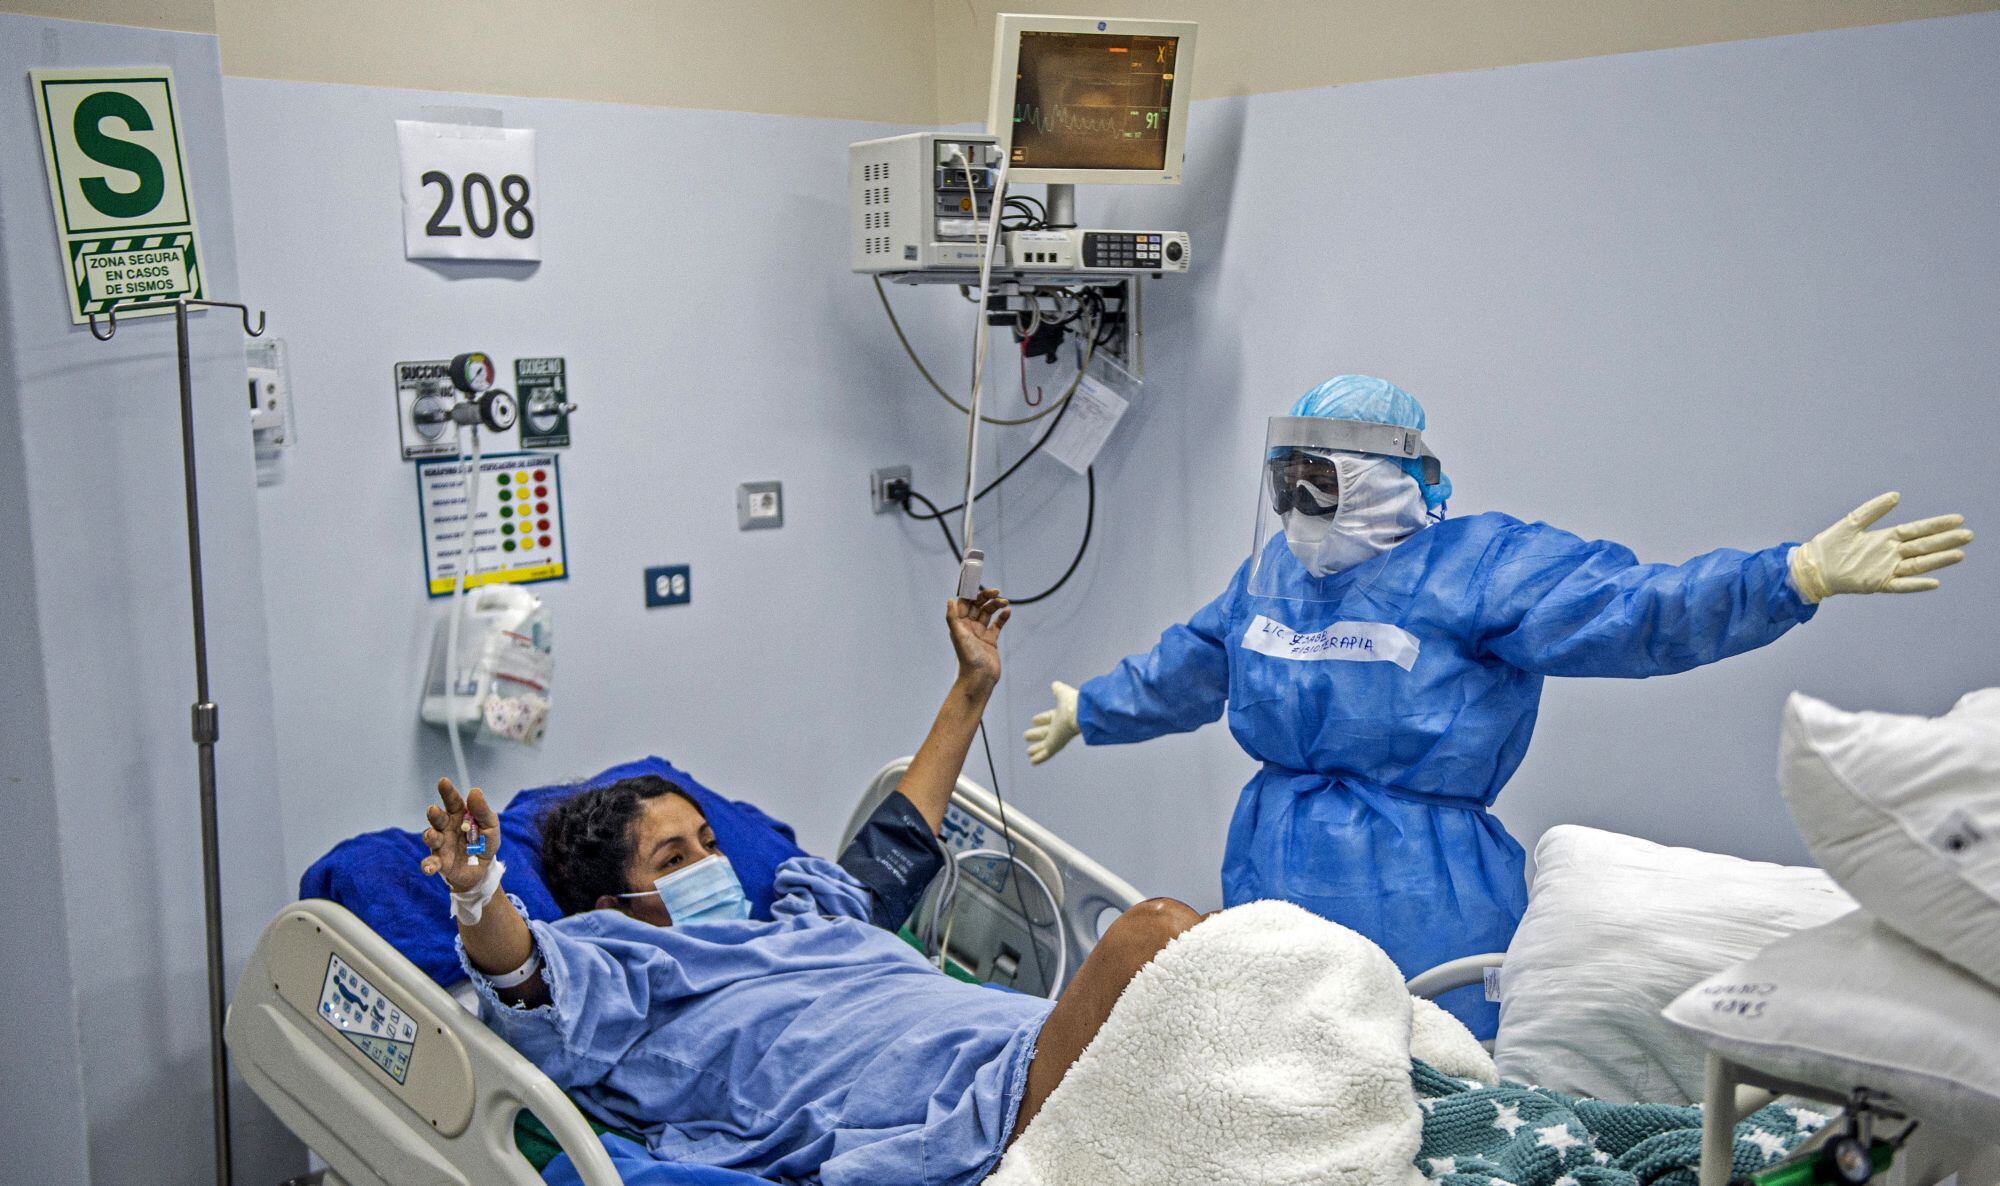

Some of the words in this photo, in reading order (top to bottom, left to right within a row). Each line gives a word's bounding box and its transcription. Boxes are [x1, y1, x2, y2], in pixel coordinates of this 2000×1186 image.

[1145, 112, 1159, 129] 91
[73, 91, 166, 219] S
[421, 170, 534, 239] 208
[89, 256, 126, 269] ZONA
[128, 251, 180, 265] SEGURA
[105, 270, 123, 281] EN
[126, 266, 170, 279] CASOS
[105, 284, 123, 295] DE
[126, 279, 174, 293] SISMOS
[1262, 622, 1284, 639] LIC.
